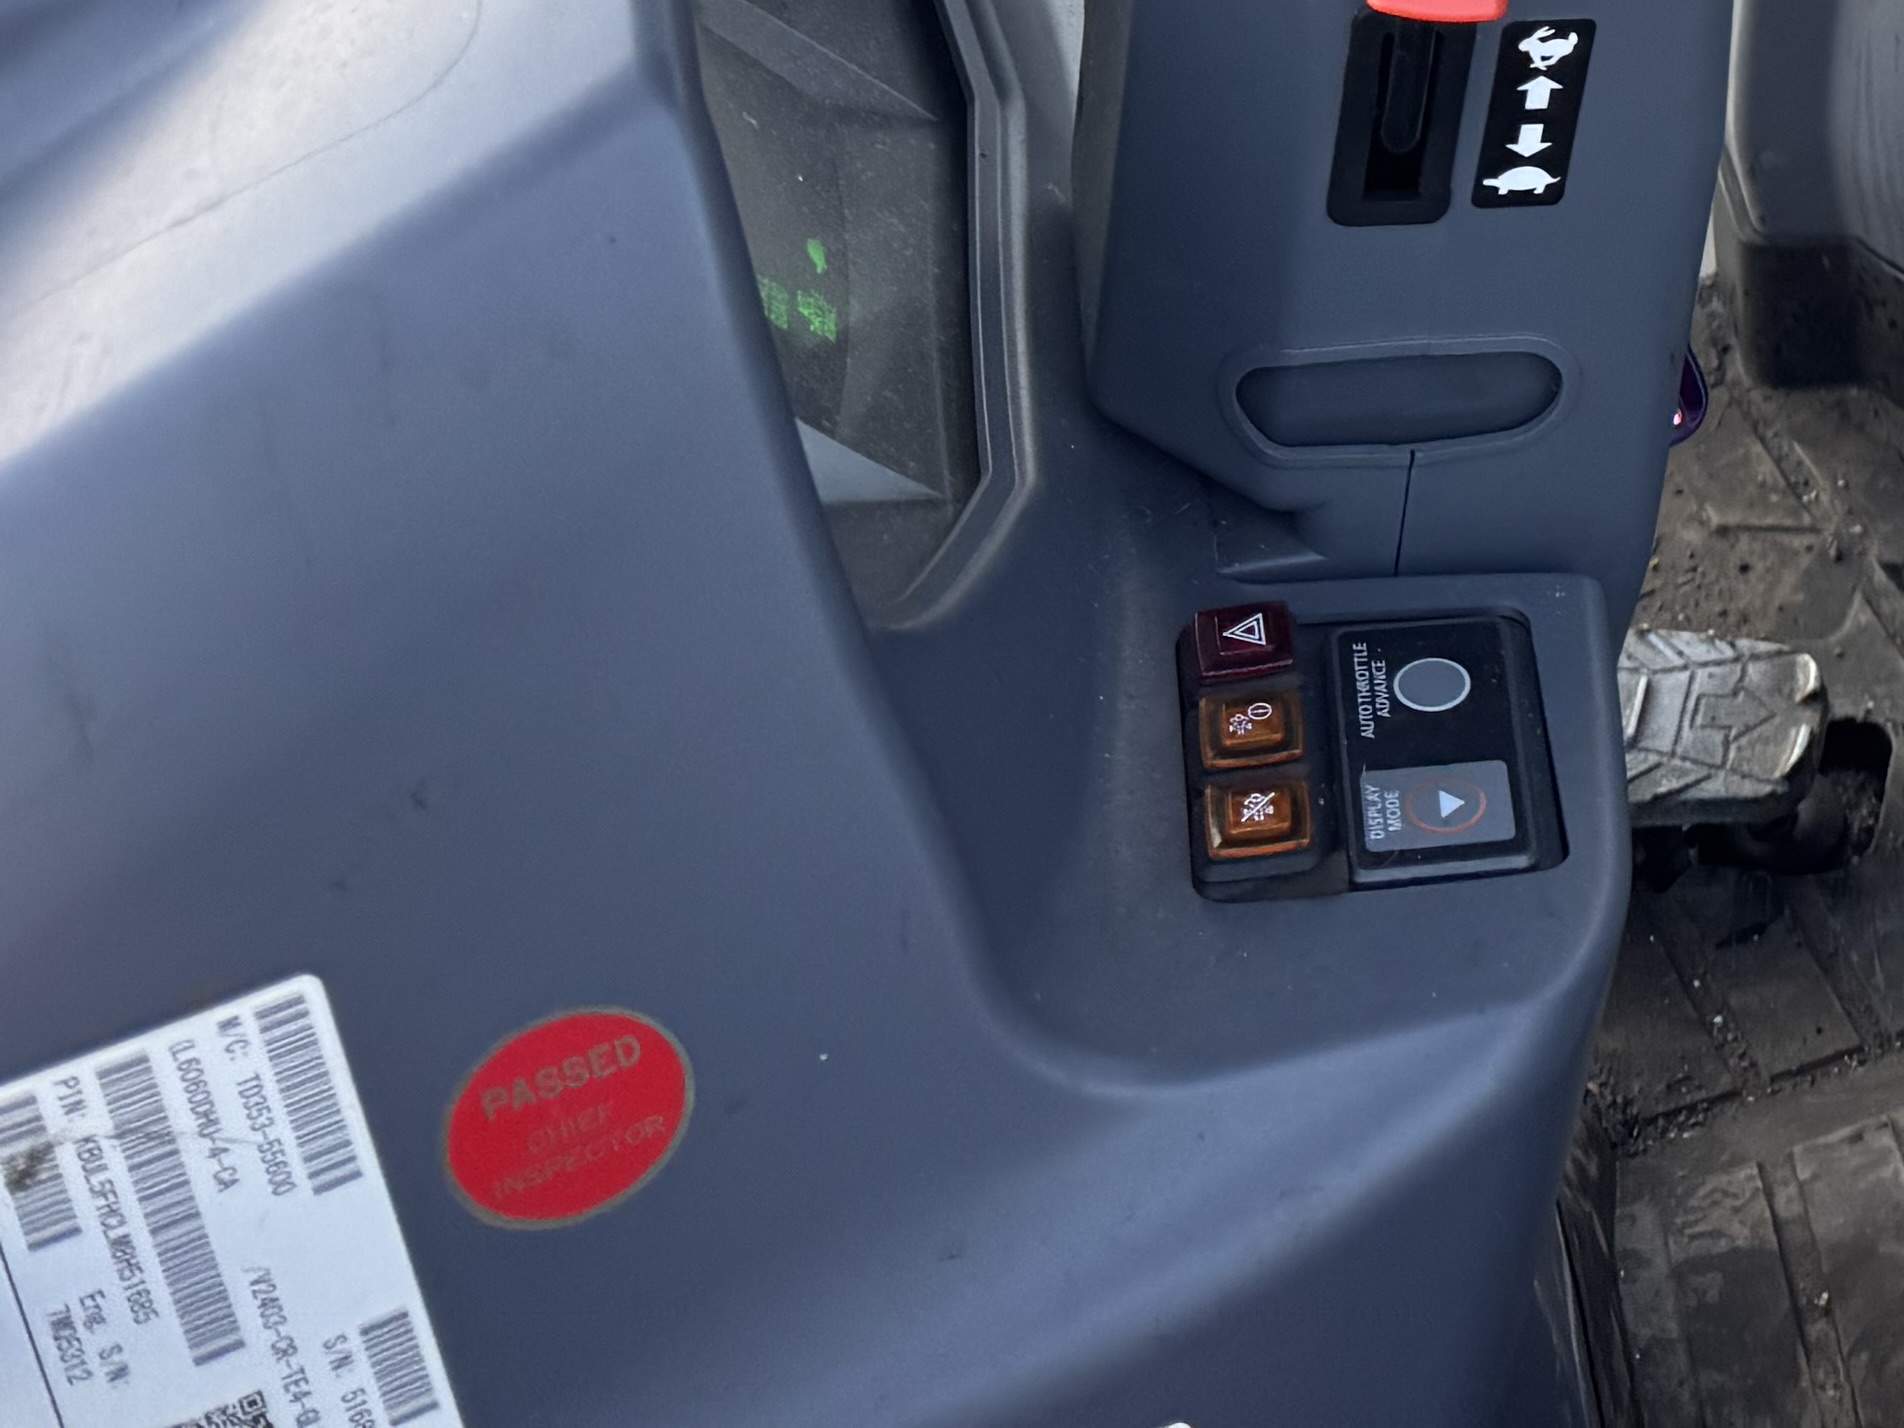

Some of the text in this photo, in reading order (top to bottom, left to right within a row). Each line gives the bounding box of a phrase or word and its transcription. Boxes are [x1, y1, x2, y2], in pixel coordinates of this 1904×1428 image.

[1352, 642, 1375, 738] AUTO THROTTLE
[1374, 658, 1391, 718] ADVANCE
[1366, 784, 1384, 841] DISPLAY
[1386, 791, 1400, 831] MODE
[480, 1035, 642, 1124] PASSED
